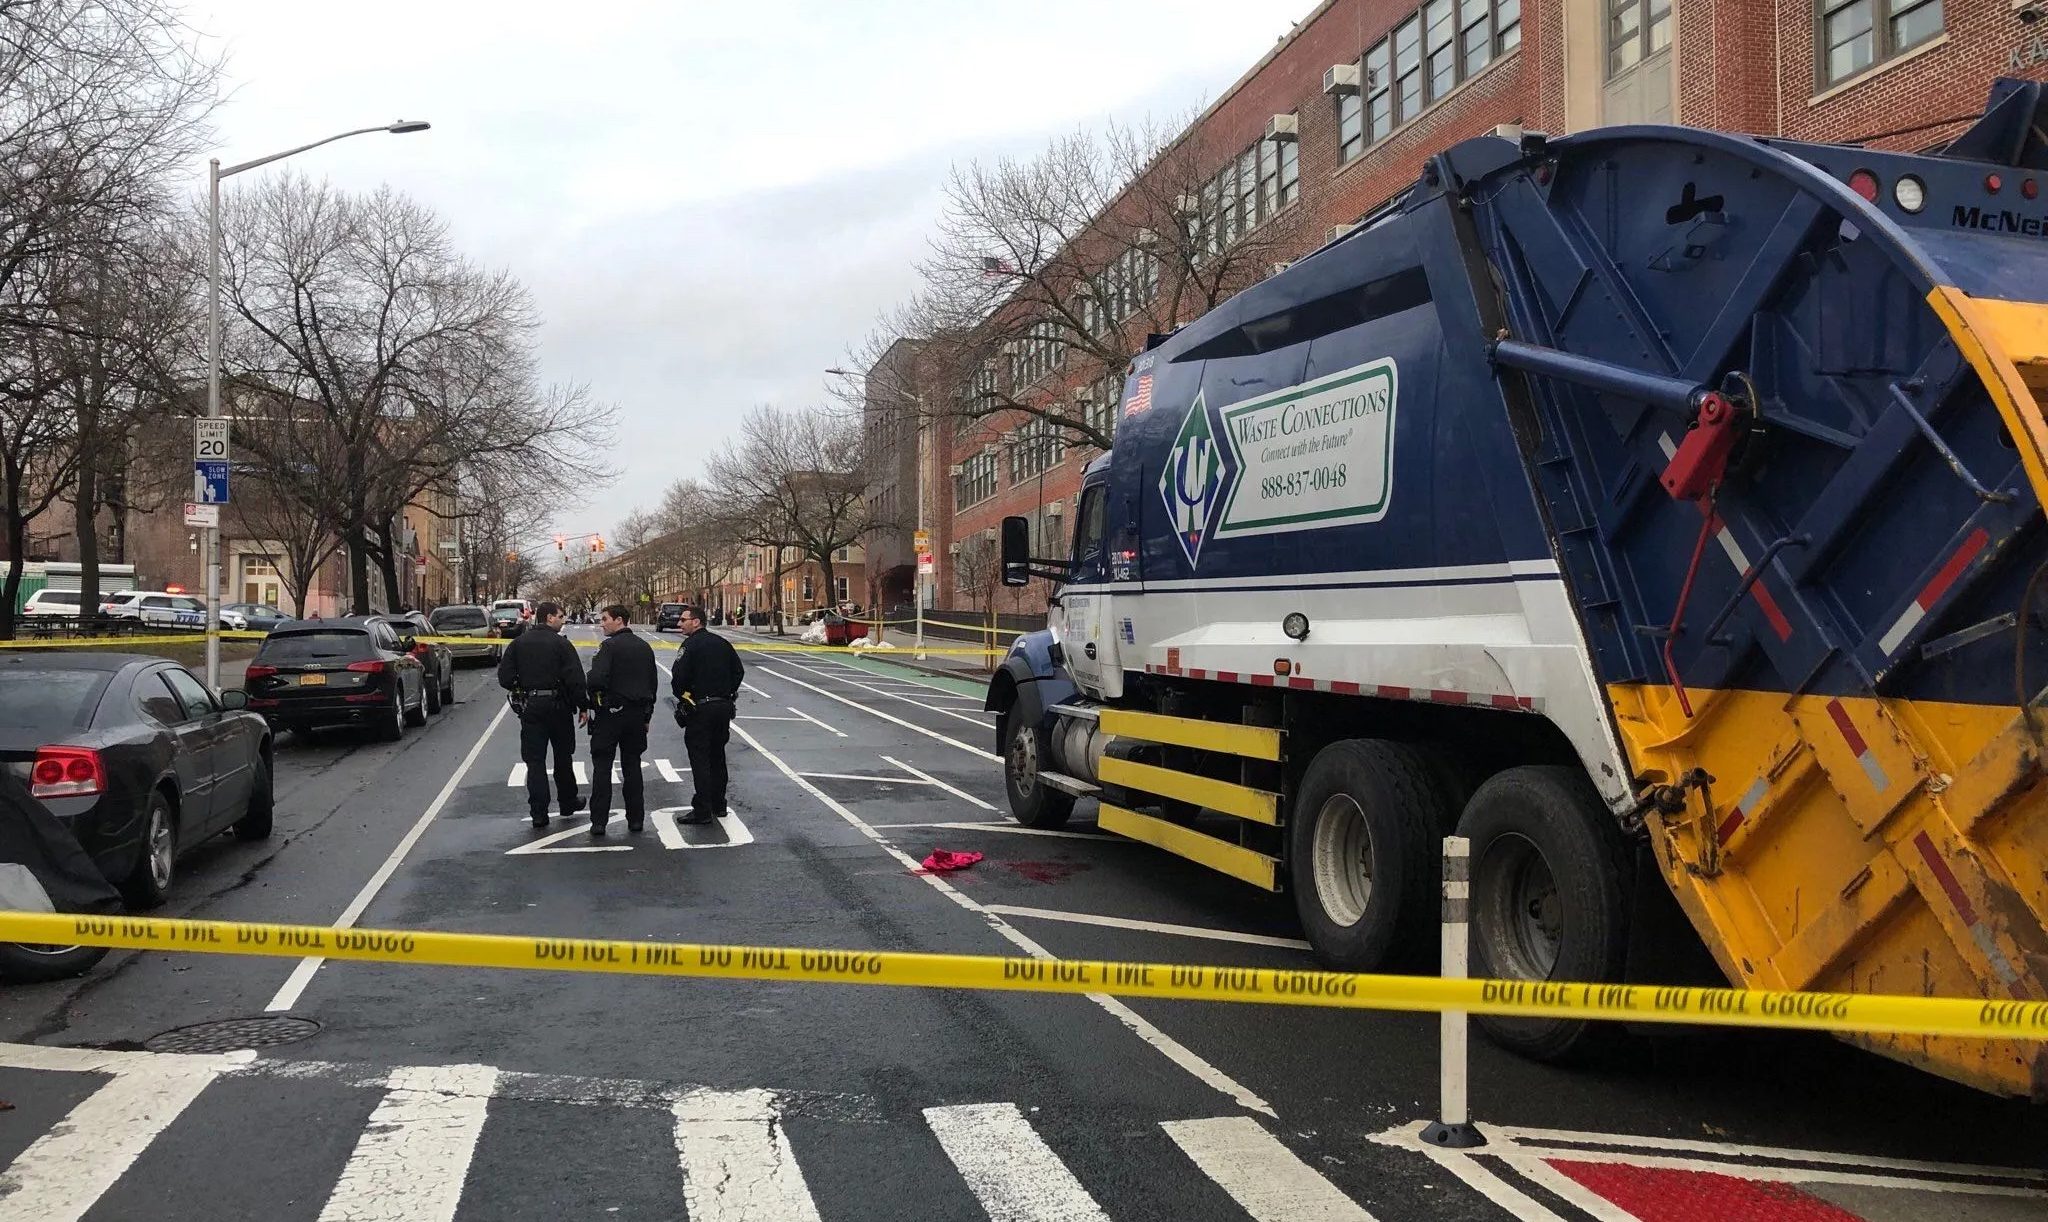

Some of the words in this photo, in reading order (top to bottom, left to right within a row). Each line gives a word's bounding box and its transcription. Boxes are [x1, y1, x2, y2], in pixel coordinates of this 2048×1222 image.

[1238, 415, 1278, 446] WASTE
[1282, 388, 1387, 436] CONNECTIONS
[200, 440, 224, 455] 20
[1261, 444, 1290, 464] Connect
[1291, 438, 1307, 458] with
[1308, 437, 1320, 454] the
[1261, 463, 1347, 500] 888-837-0048
